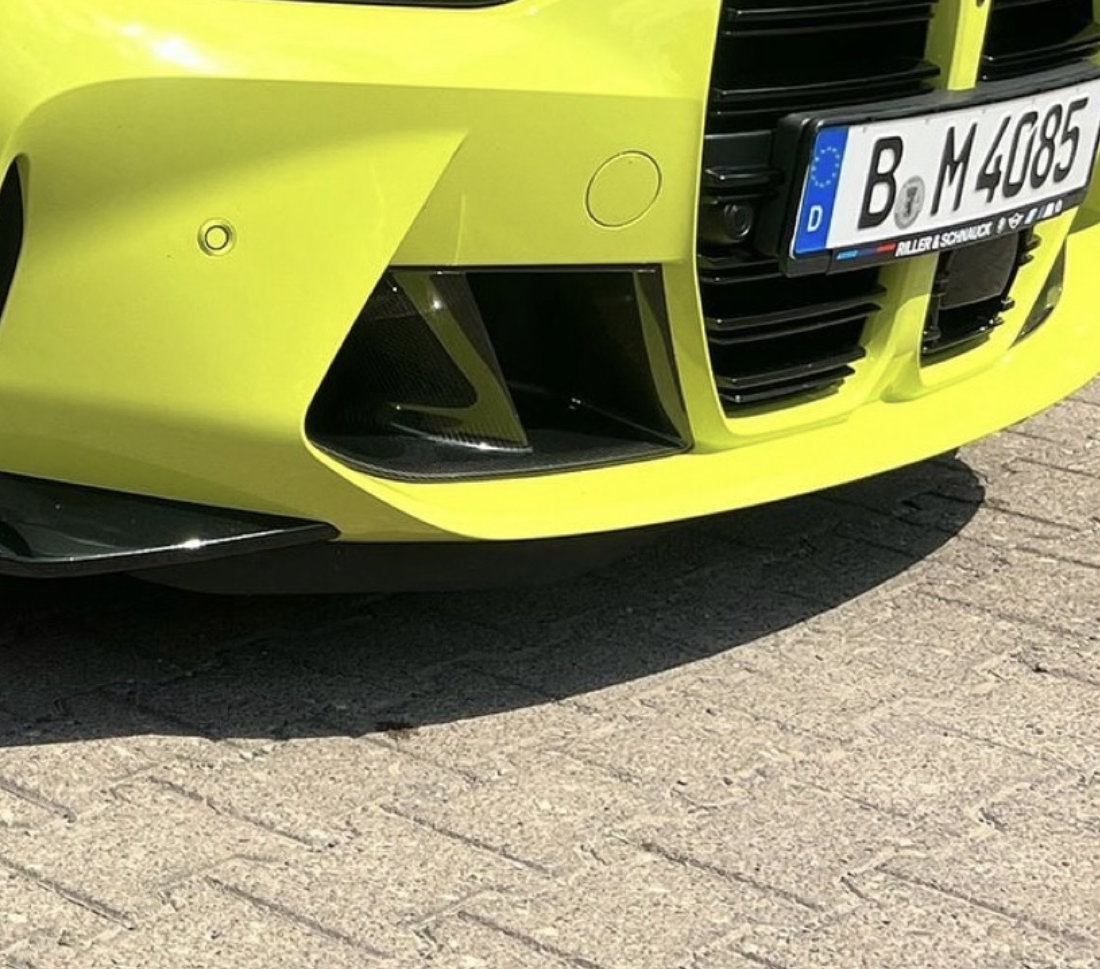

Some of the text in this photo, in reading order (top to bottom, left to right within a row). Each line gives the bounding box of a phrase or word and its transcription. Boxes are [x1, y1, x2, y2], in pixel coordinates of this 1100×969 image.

[857, 96, 1089, 229] B M 4085
[807, 205, 824, 232] D
